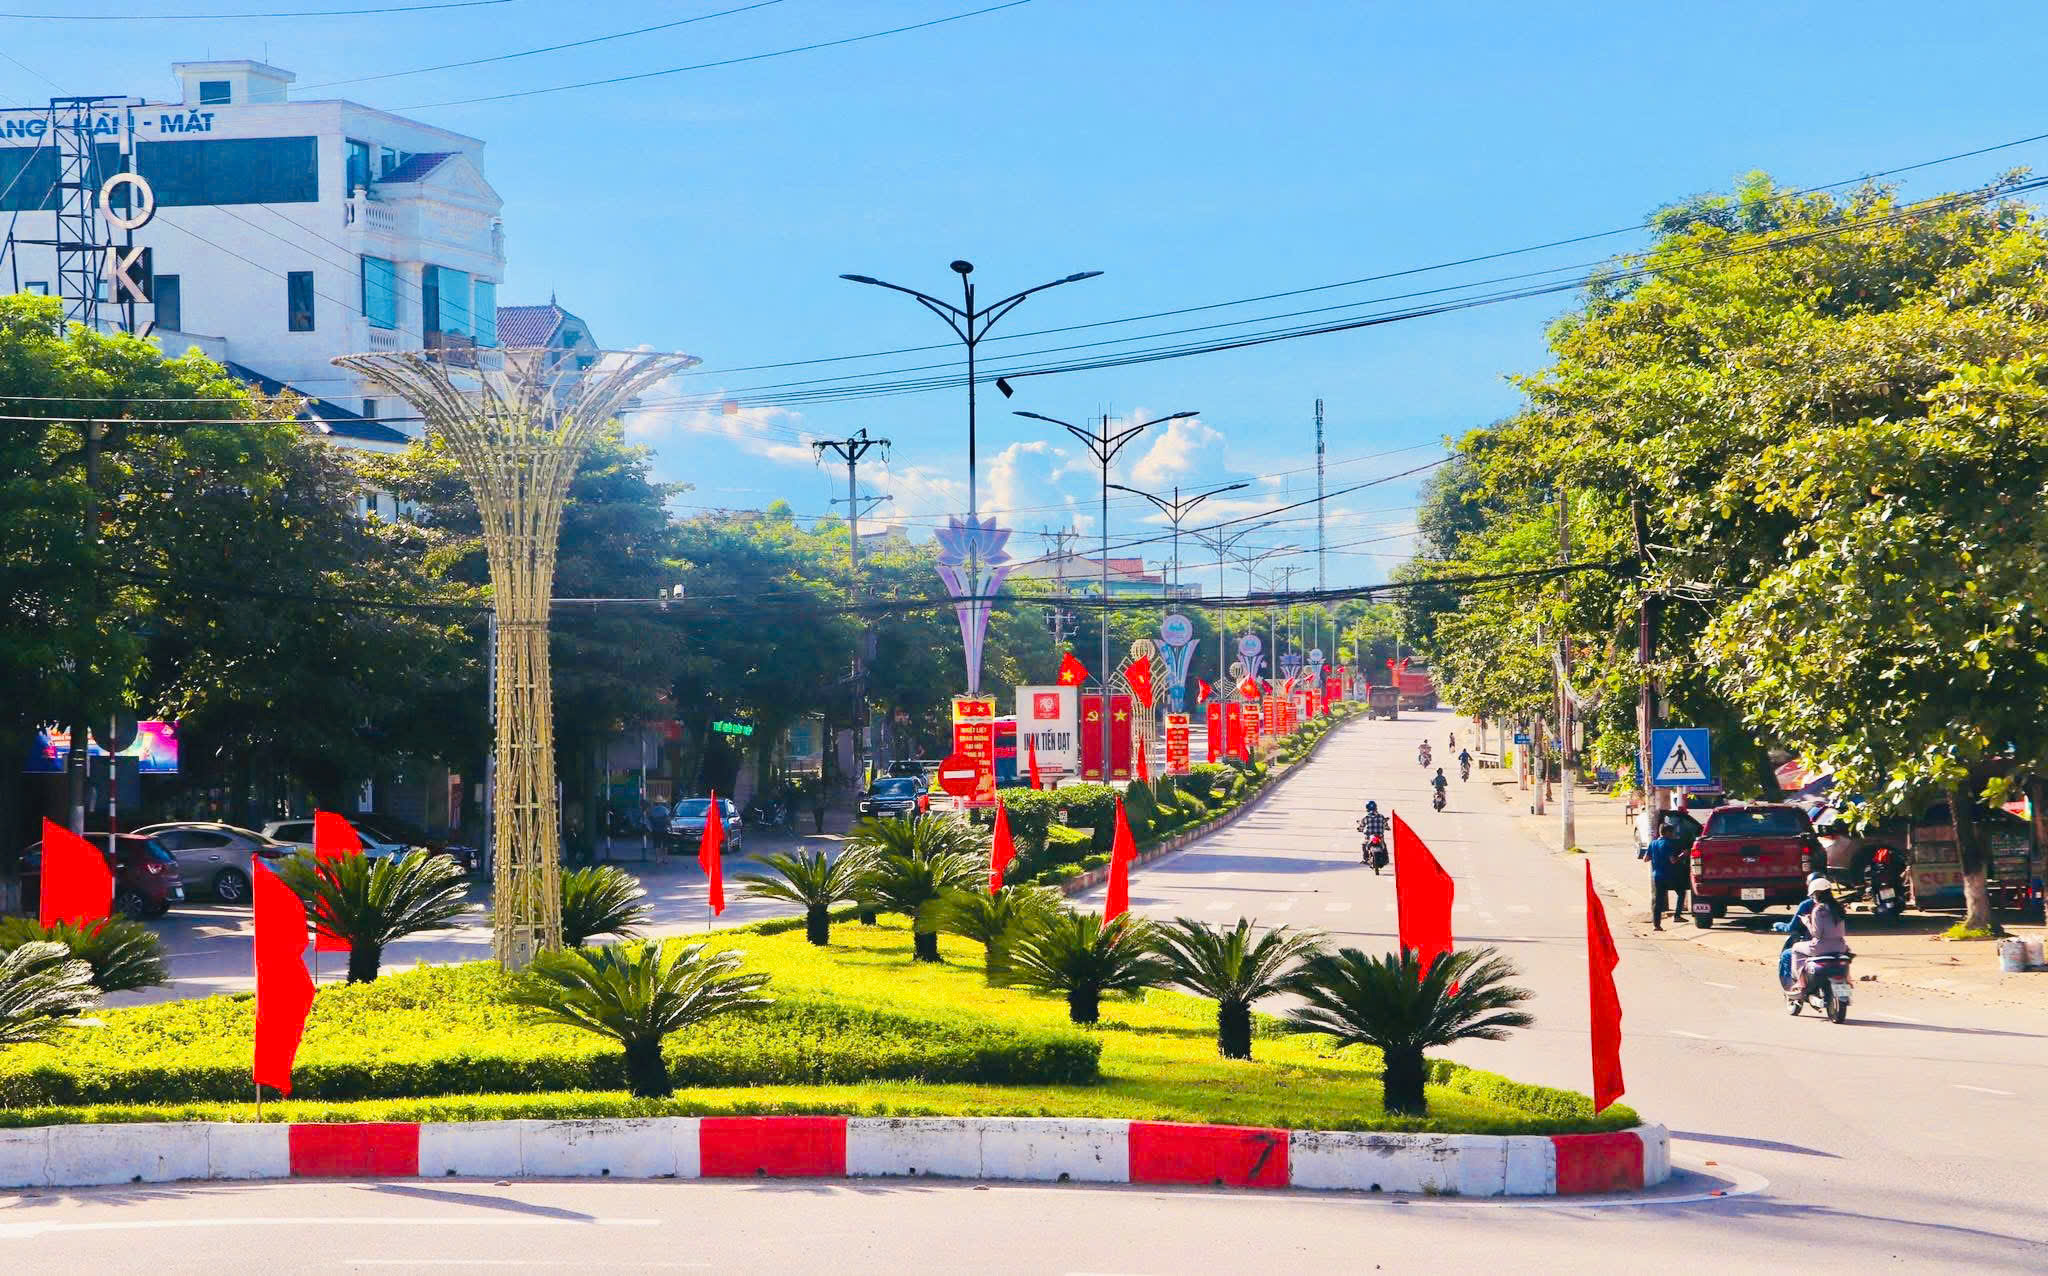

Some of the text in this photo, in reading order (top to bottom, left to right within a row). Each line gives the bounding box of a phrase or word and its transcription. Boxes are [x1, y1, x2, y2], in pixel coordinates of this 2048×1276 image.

[0, 118, 47, 138] NG
[160, 109, 215, 134] MẶT
[1041, 728, 1056, 751] TIẾN
